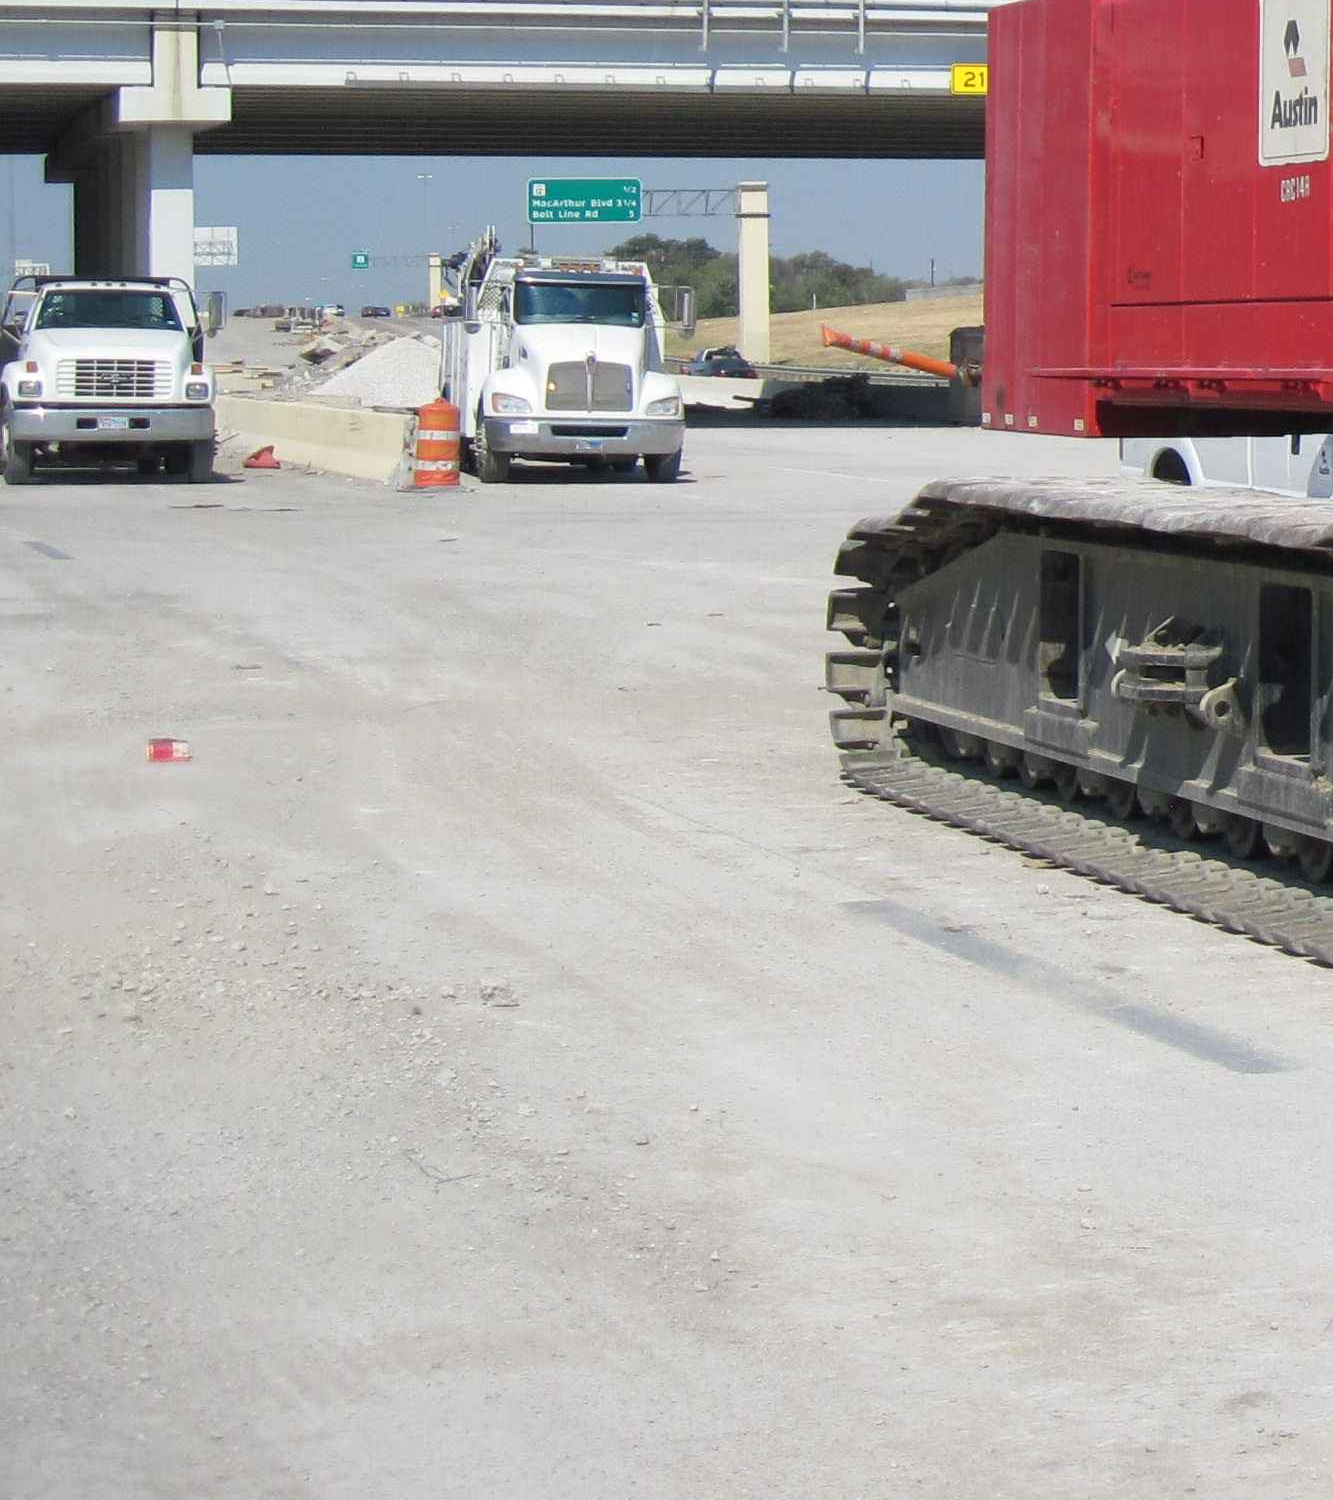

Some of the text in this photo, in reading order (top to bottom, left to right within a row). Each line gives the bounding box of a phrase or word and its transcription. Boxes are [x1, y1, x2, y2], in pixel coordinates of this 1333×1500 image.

[964, 71, 984, 87] 21
[1270, 86, 1318, 129] Austin
[532, 199, 586, 207] MacArthur
[591, 199, 613, 207] Blvd
[532, 210, 554, 218] Belt
[558, 210, 580, 218] Line
[585, 210, 599, 218] Rd
